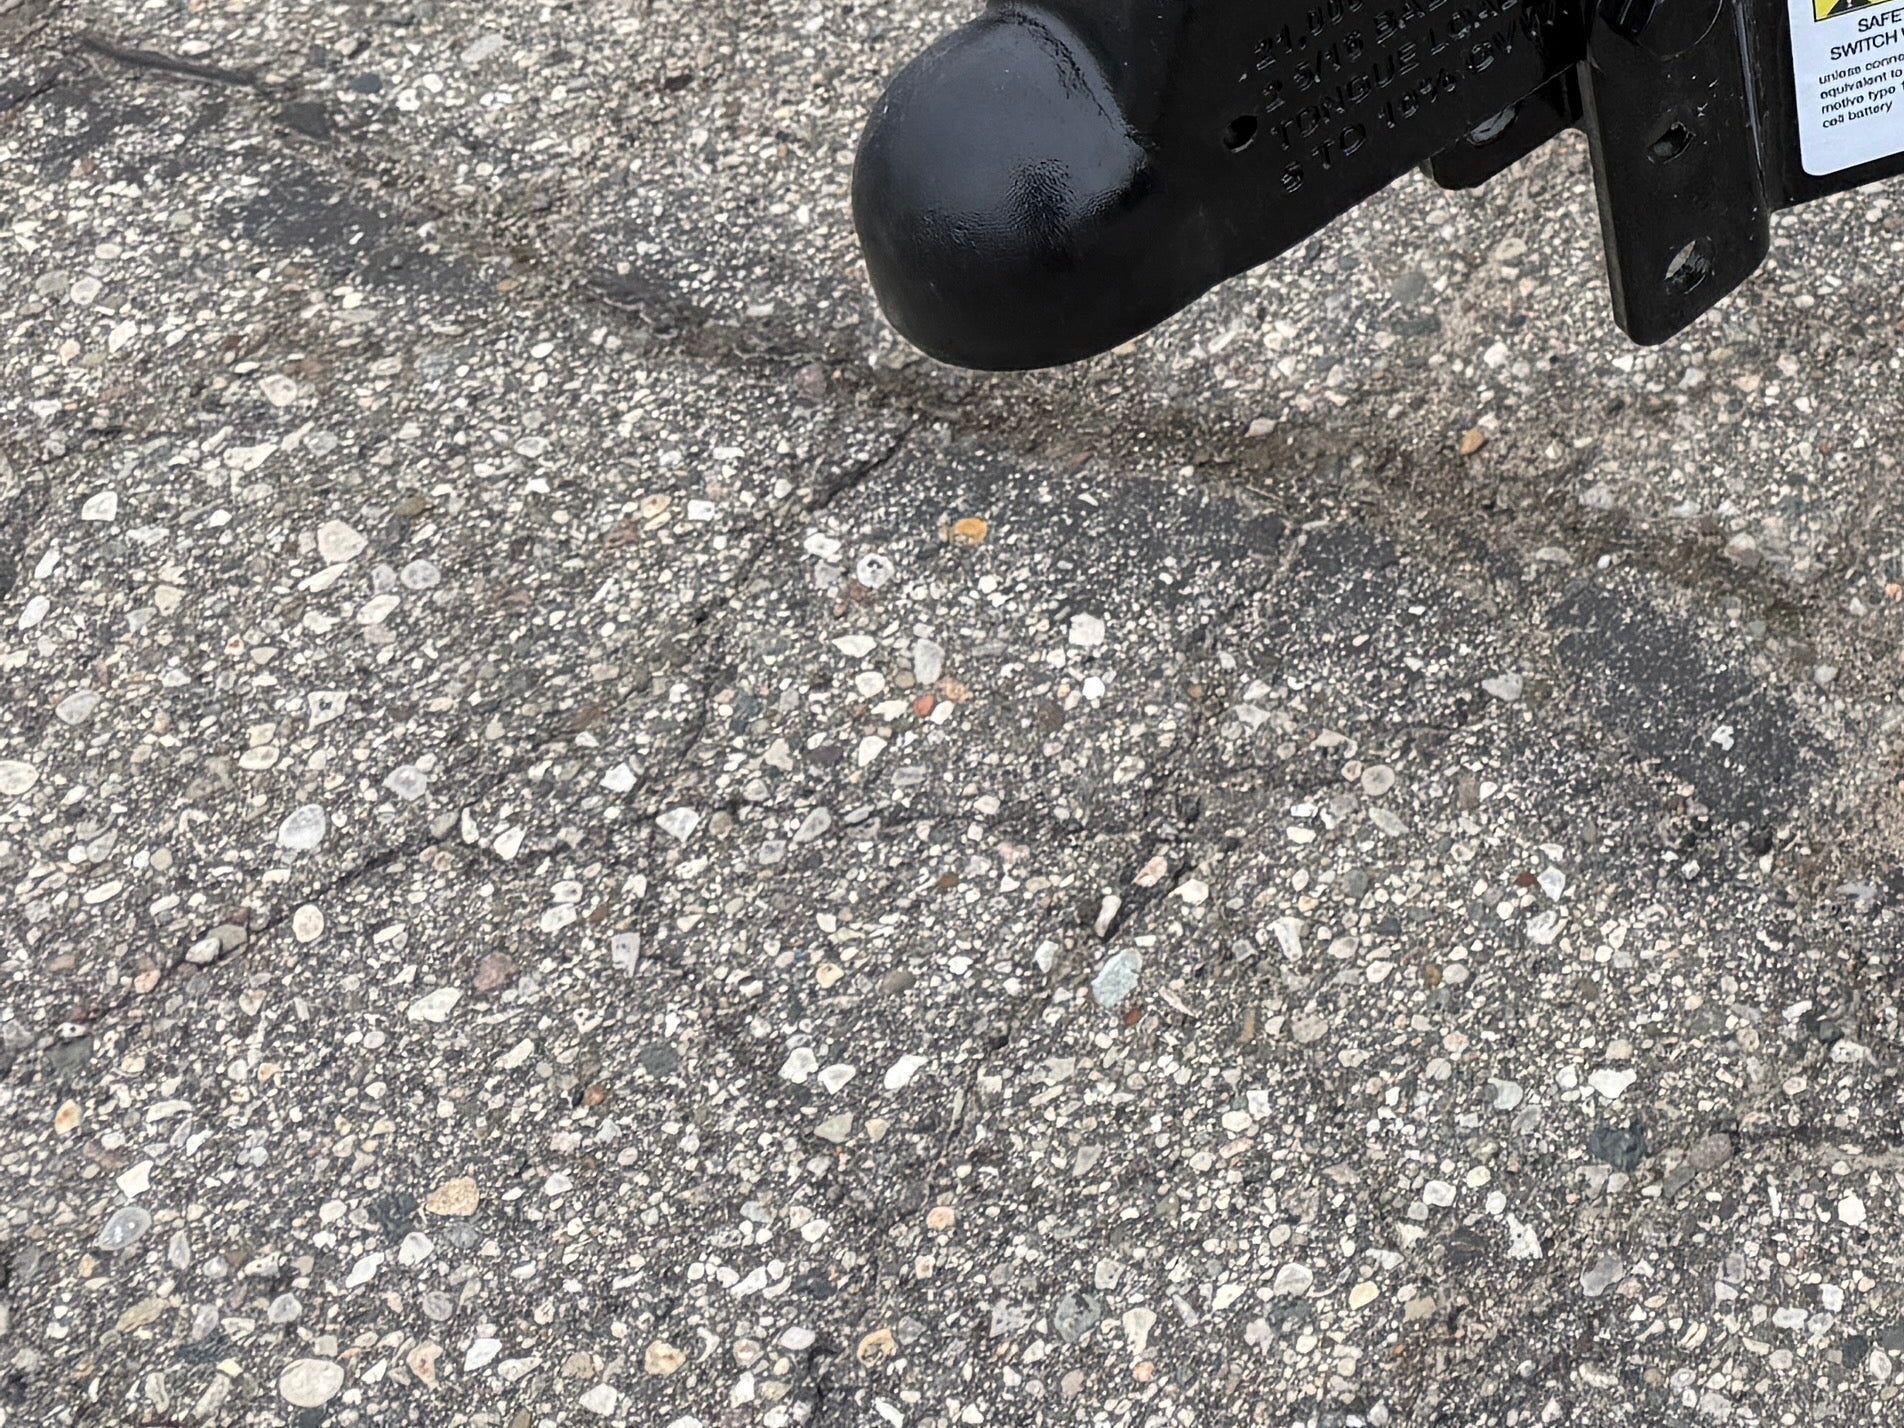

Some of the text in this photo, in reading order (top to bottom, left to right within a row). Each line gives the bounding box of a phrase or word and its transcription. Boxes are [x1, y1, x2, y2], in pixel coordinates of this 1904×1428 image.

[1830, 29, 1898, 61] SWITCH
[1890, 68, 1903, 79] to
[1261, 79, 1287, 113] 2
[1270, 43, 1420, 152] TONGUE
[1868, 85, 1896, 102] type
[1848, 100, 1893, 121] battery
[1311, 123, 1367, 170] TO
